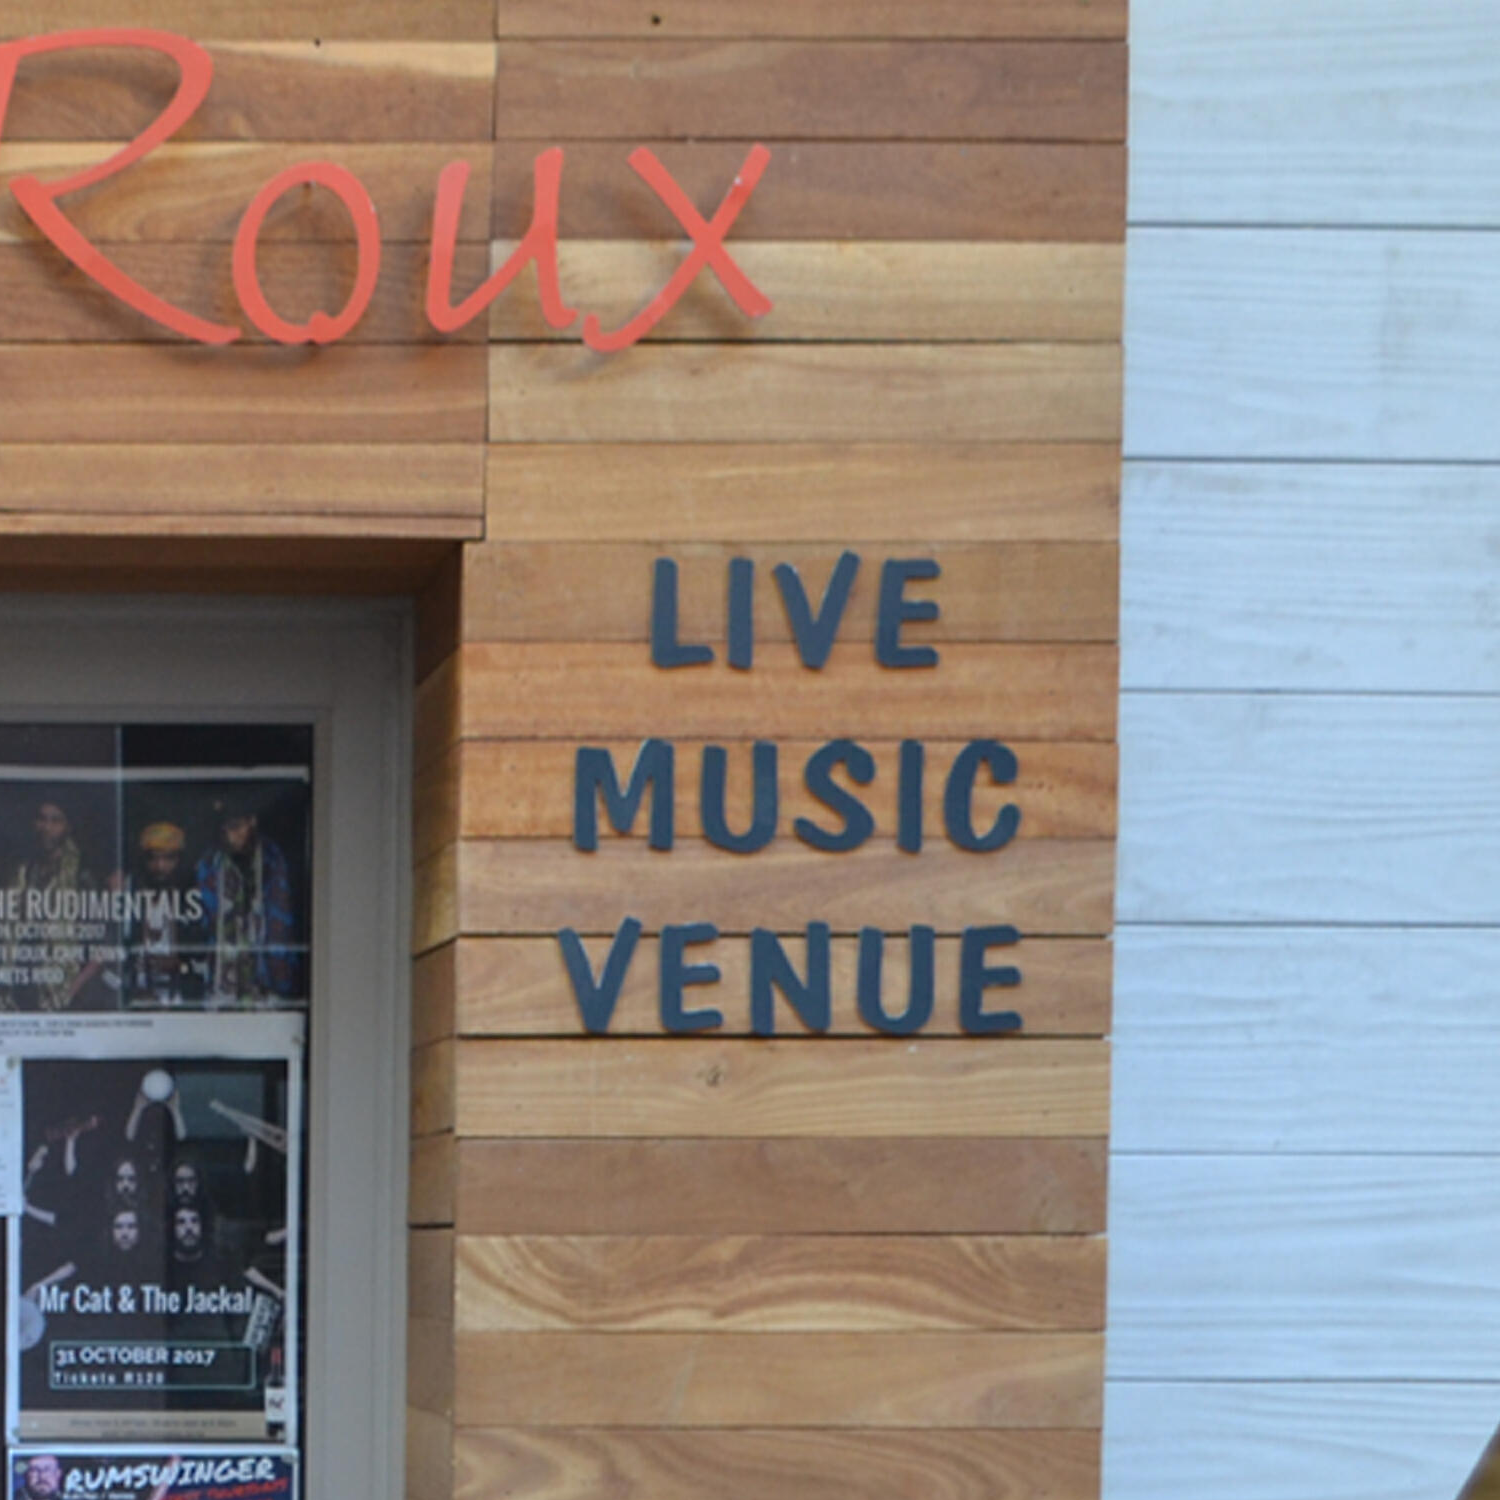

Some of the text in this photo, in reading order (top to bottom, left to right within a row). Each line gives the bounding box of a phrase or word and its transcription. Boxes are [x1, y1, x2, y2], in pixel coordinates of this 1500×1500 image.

[650, 550, 941, 671] LIVE
[573, 738, 1021, 854] MUSIC
[26, 888, 204, 920] RUDIMENTALS
[557, 916, 1023, 1035] VENUE
[40, 1284, 253, 1315] Mr Cat & The Jackal
[79, 1346, 170, 1365] OCTOBER
[172, 1349, 216, 1367] 2017
[65, 1456, 276, 1494] RUMSWINGER
